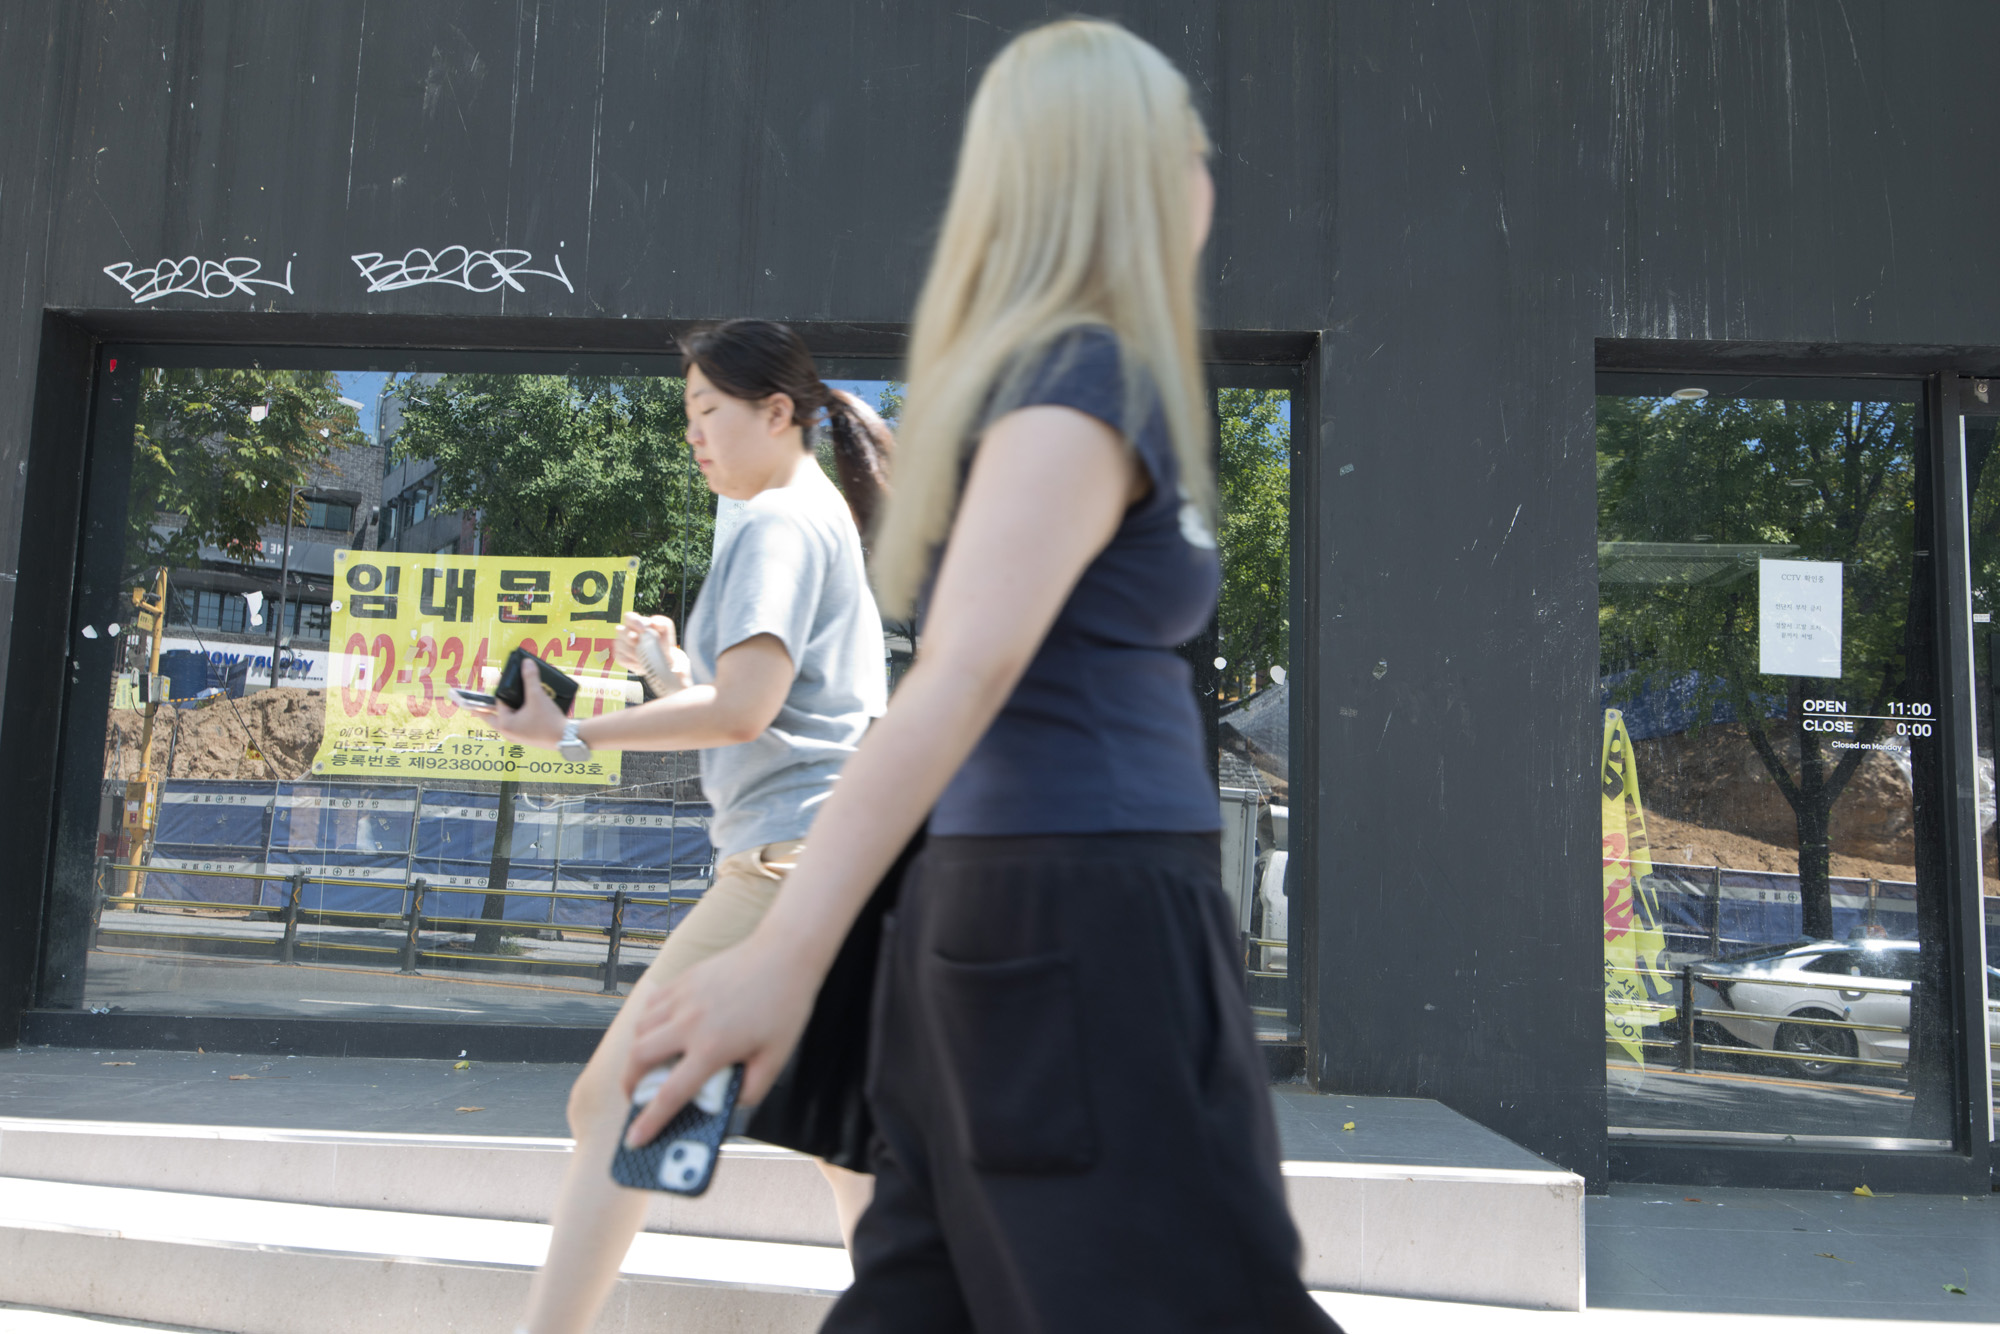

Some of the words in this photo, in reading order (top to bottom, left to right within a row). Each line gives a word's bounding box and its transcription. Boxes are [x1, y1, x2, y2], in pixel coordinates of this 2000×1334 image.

[1781, 573, 1801, 582] CCTV
[1802, 699, 1847, 713] OPEN
[1887, 701, 1932, 716] 11:00
[1802, 719, 1854, 733] CLOSE
[1896, 722, 1932, 737] 0:00
[451, 743, 490, 757] 187,
[498, 744, 526, 759] 1층
[1831, 740, 1860, 750] Closed
[1872, 742, 1903, 752] Monday
[331, 754, 402, 769] 등록번호
[408, 756, 604, 776] 제92380000-00733호
